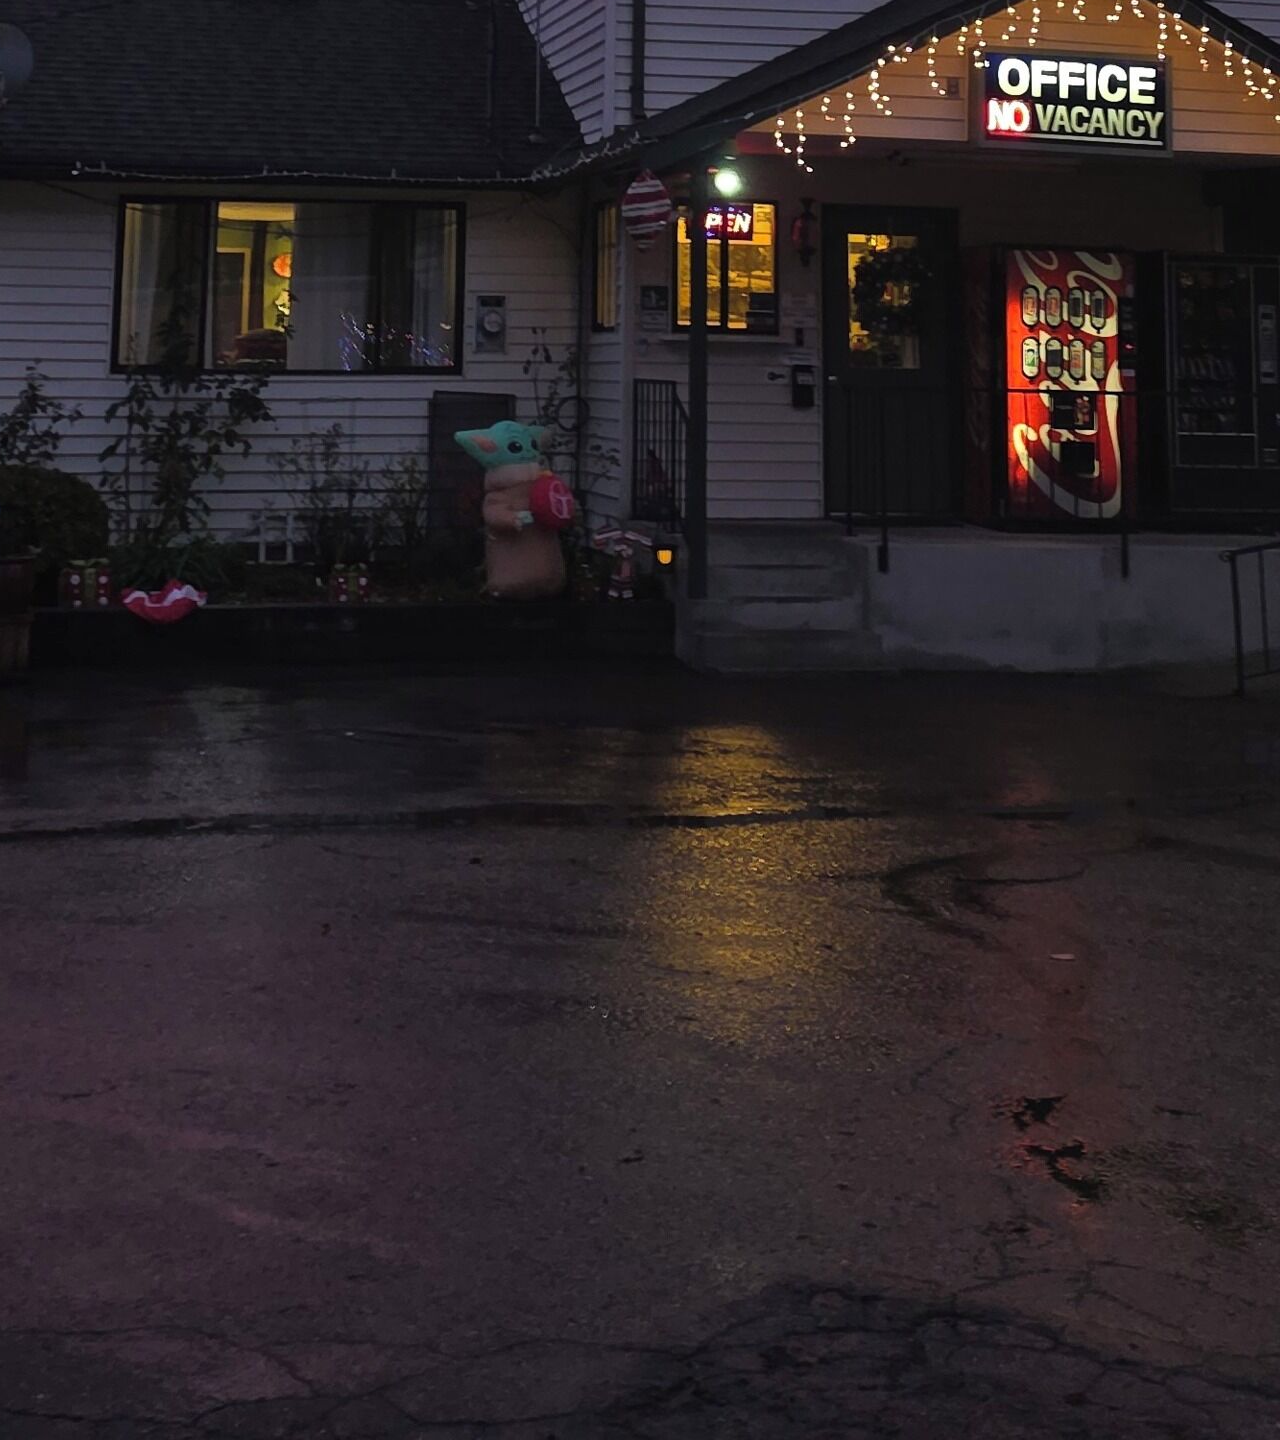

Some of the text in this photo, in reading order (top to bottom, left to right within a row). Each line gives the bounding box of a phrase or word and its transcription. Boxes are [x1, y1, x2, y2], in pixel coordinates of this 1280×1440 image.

[997, 57, 1157, 105] OFFICE
[987, 98, 1164, 139] NO VACANCY
[704, 212, 752, 233] PEN
